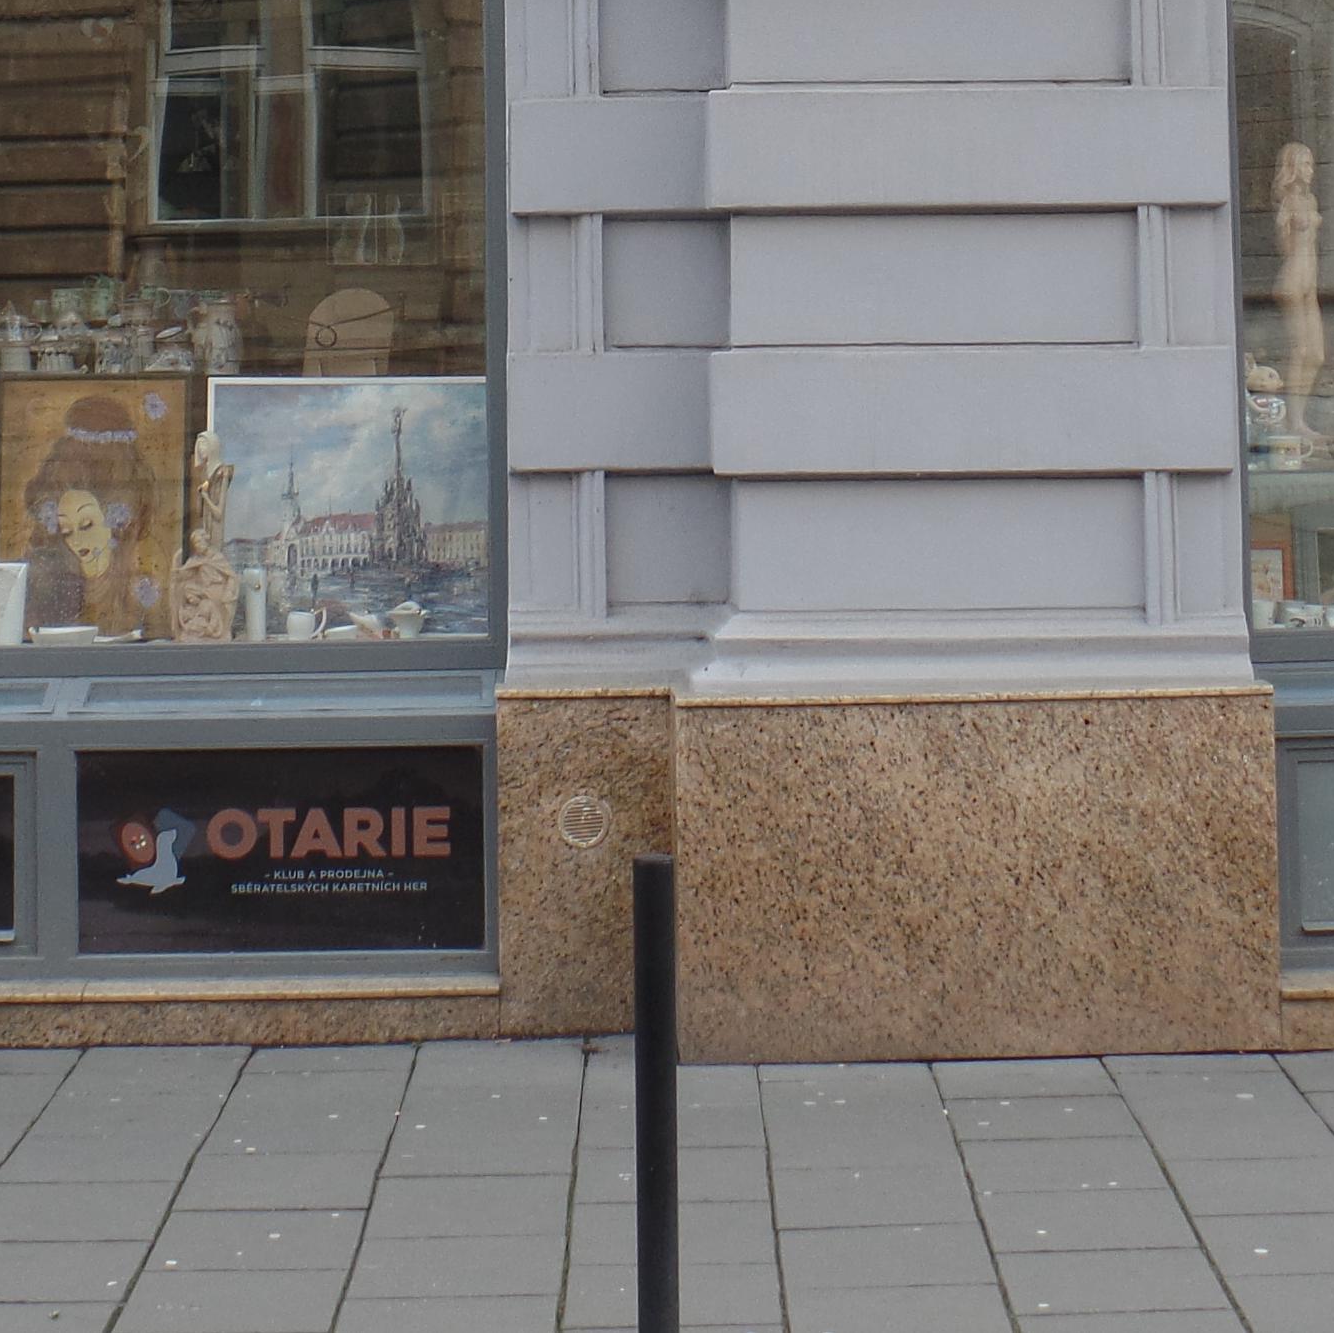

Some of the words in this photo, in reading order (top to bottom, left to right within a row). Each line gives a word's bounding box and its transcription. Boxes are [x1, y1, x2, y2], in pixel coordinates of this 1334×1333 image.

[206, 806, 452, 860] OTARIE
[273, 870, 305, 880] KLUB
[307, 870, 317, 879] A
[320, 868, 385, 879] PRODEJNA
[331, 879, 401, 893] KARETNÍCH
[403, 881, 428, 892] HER
